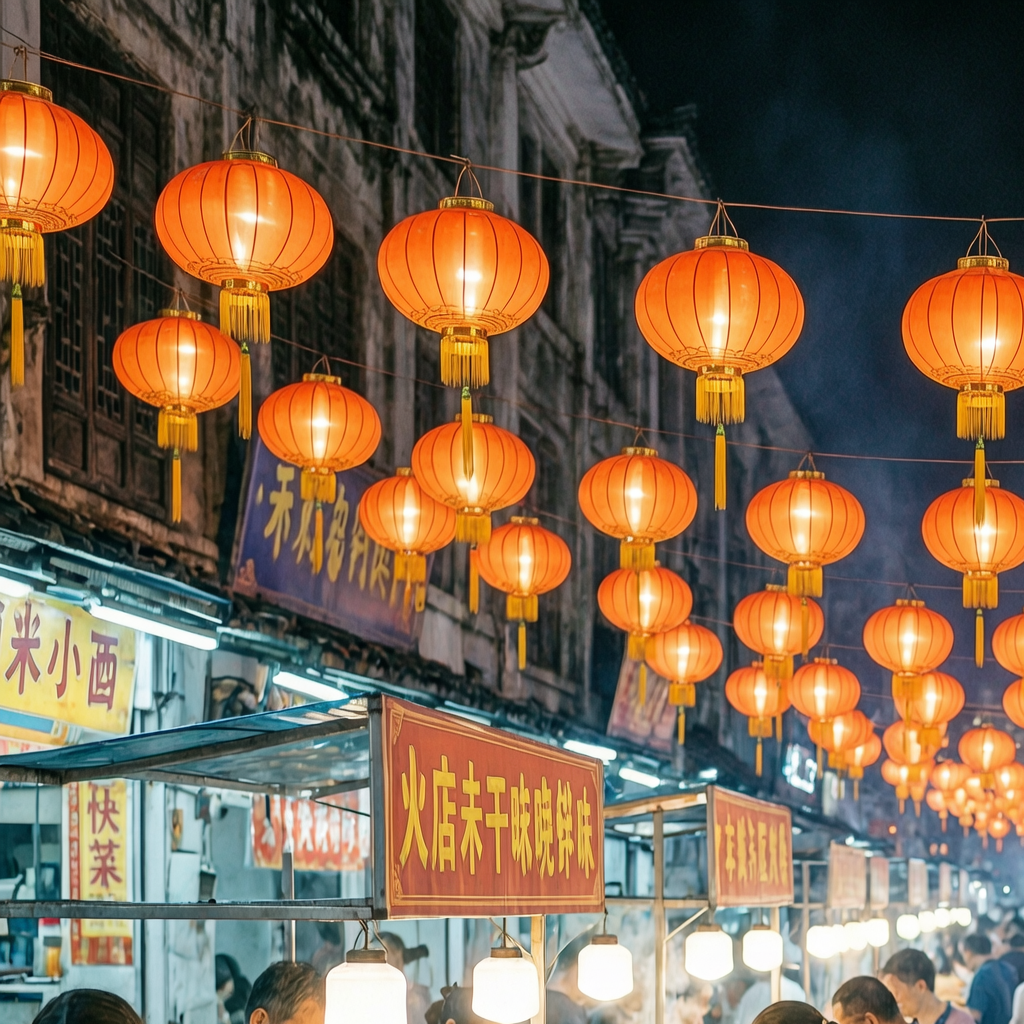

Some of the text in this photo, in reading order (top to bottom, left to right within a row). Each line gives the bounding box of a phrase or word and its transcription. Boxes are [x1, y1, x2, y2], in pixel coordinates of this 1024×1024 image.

[0, 600, 118, 711] 米小酉
[87, 786, 123, 888] 快菜
